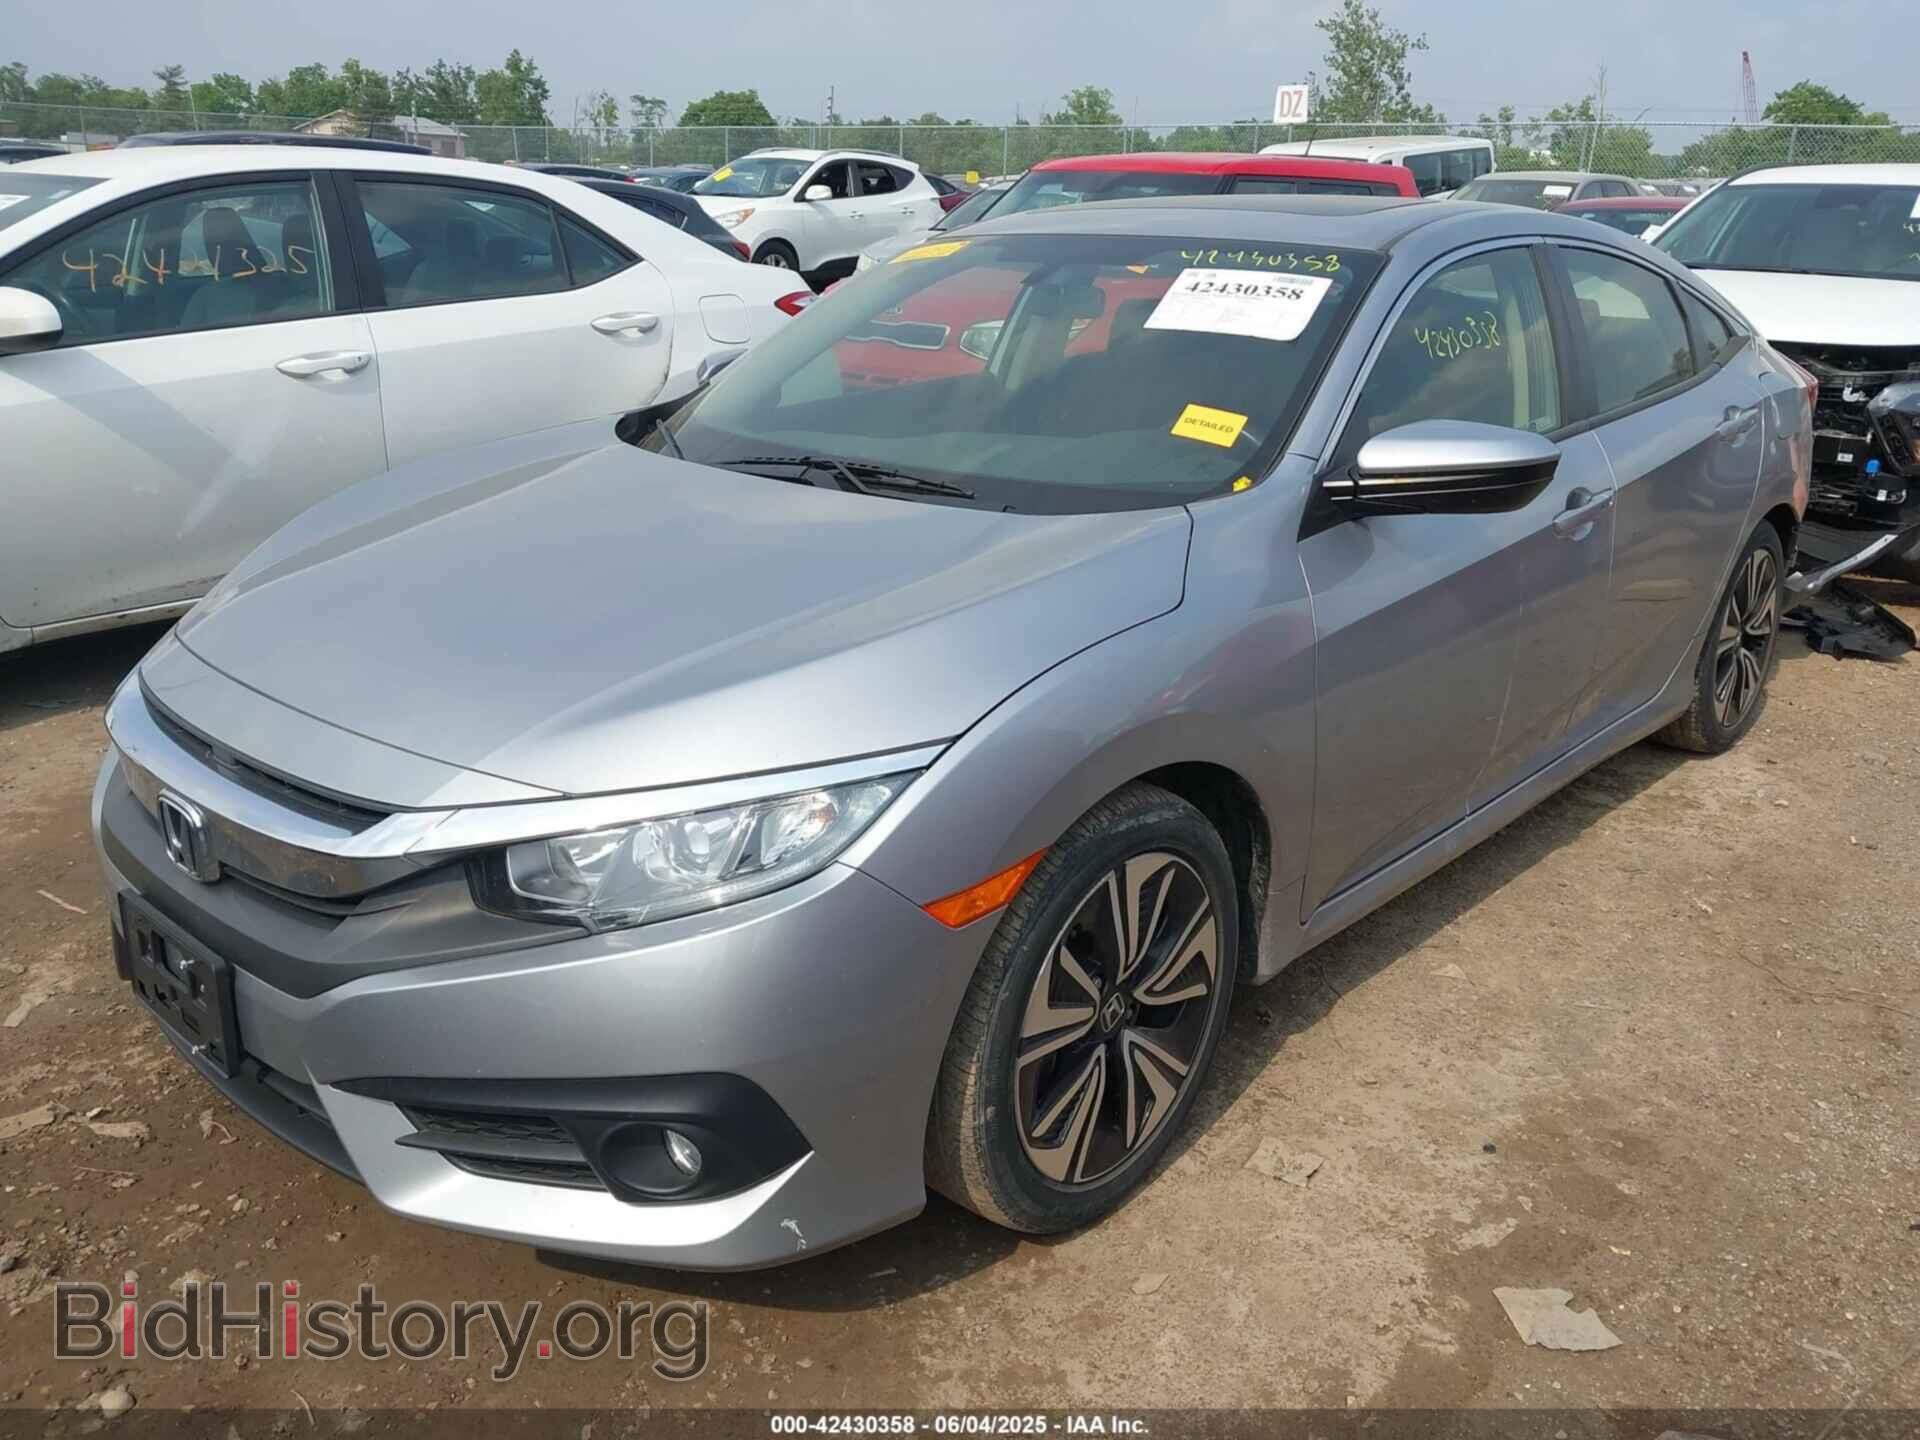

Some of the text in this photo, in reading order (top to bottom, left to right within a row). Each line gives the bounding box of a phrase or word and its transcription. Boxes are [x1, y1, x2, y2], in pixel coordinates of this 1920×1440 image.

[1280, 90, 1304, 118] DZ
[1185, 281, 1305, 301] 42430358
[1184, 416, 1234, 433] DETAILED
